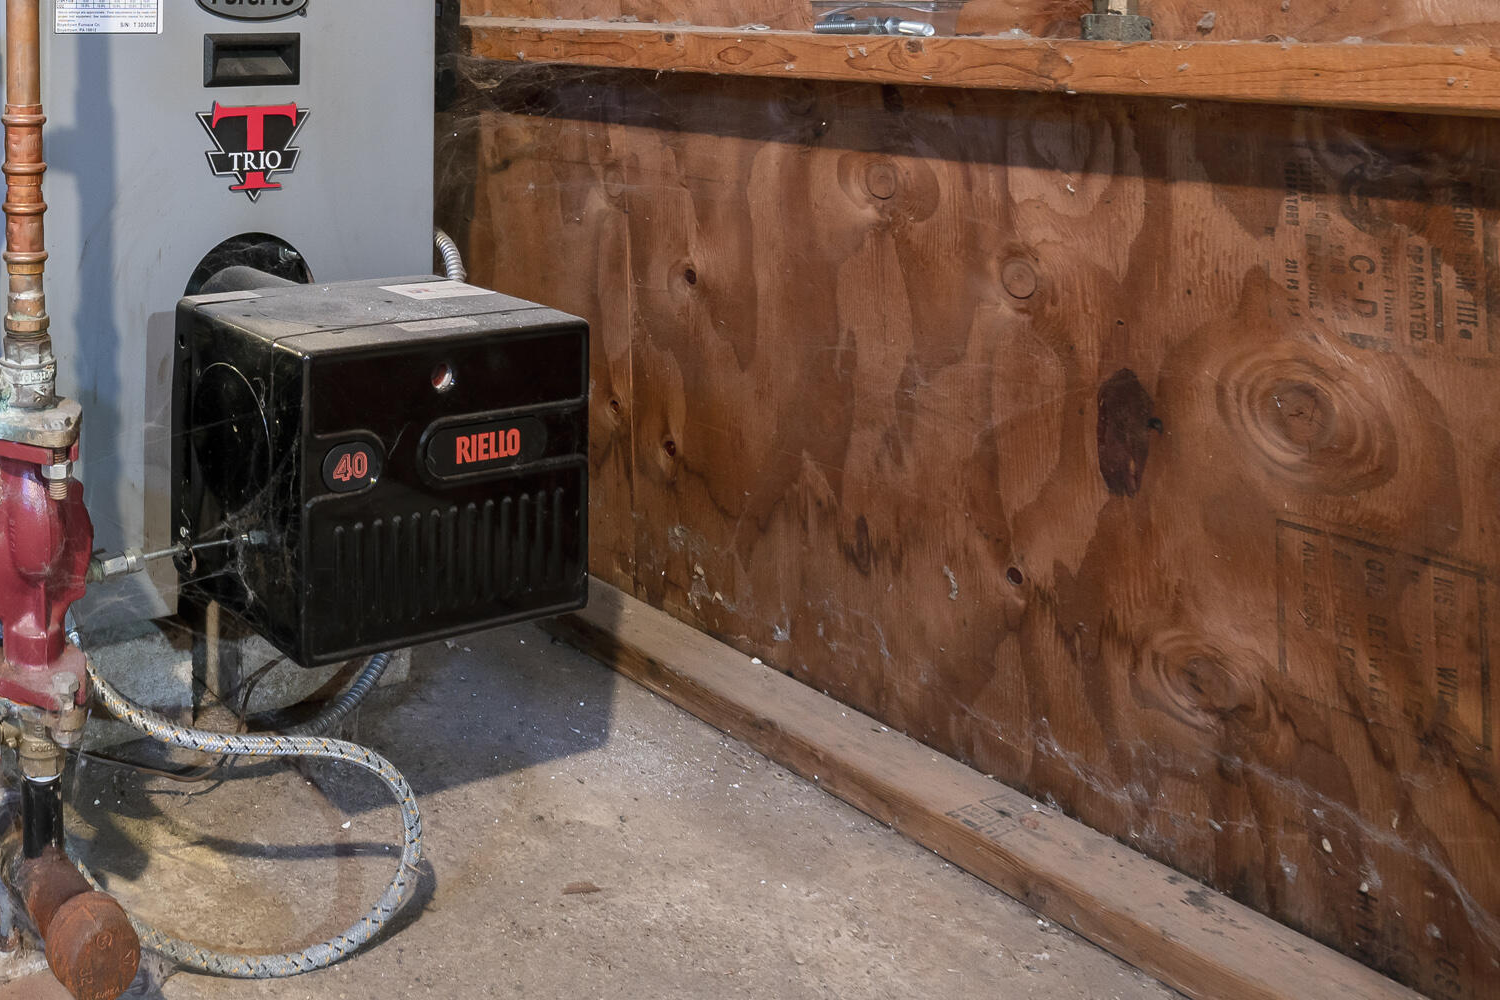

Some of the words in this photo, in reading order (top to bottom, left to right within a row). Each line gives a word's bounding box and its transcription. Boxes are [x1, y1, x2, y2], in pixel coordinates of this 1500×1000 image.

[228, 150, 282, 171] TRIO
[455, 427, 521, 465] RIELLO
[332, 451, 368, 482] 40
